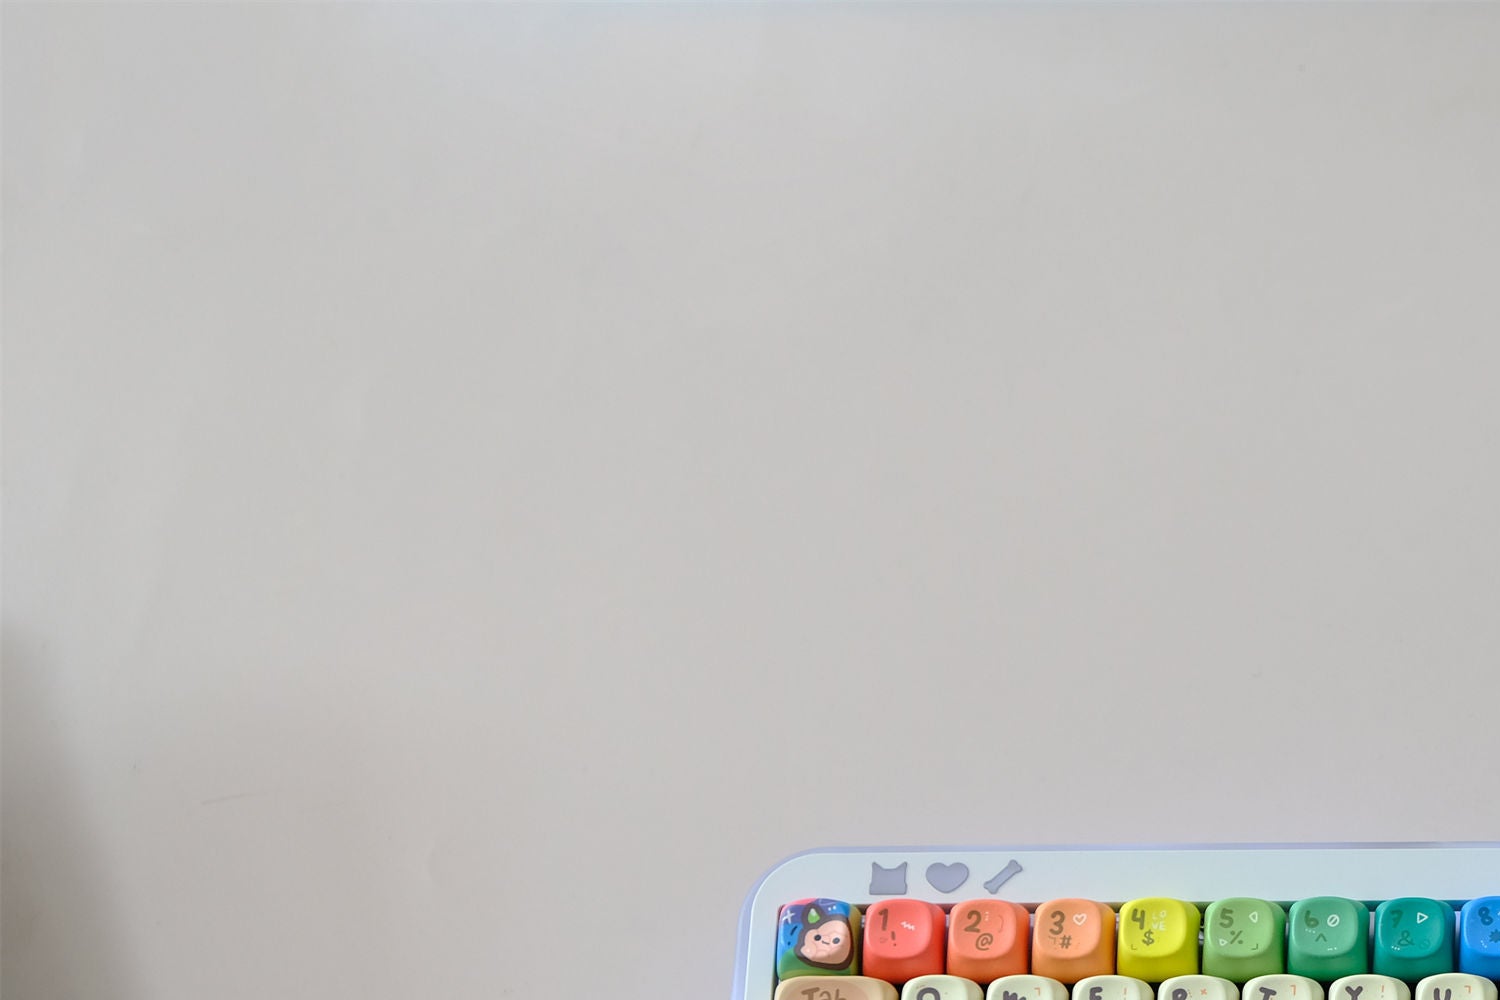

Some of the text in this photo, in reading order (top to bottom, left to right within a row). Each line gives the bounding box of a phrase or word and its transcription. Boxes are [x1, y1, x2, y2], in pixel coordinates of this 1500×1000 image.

[878, 907, 889, 931] 1
[963, 909, 982, 933] 2
[1049, 910, 1066, 935] 3
[1131, 908, 1146, 930] 4
[1219, 908, 1234, 928] 5
[1477, 906, 1493, 926] 8
